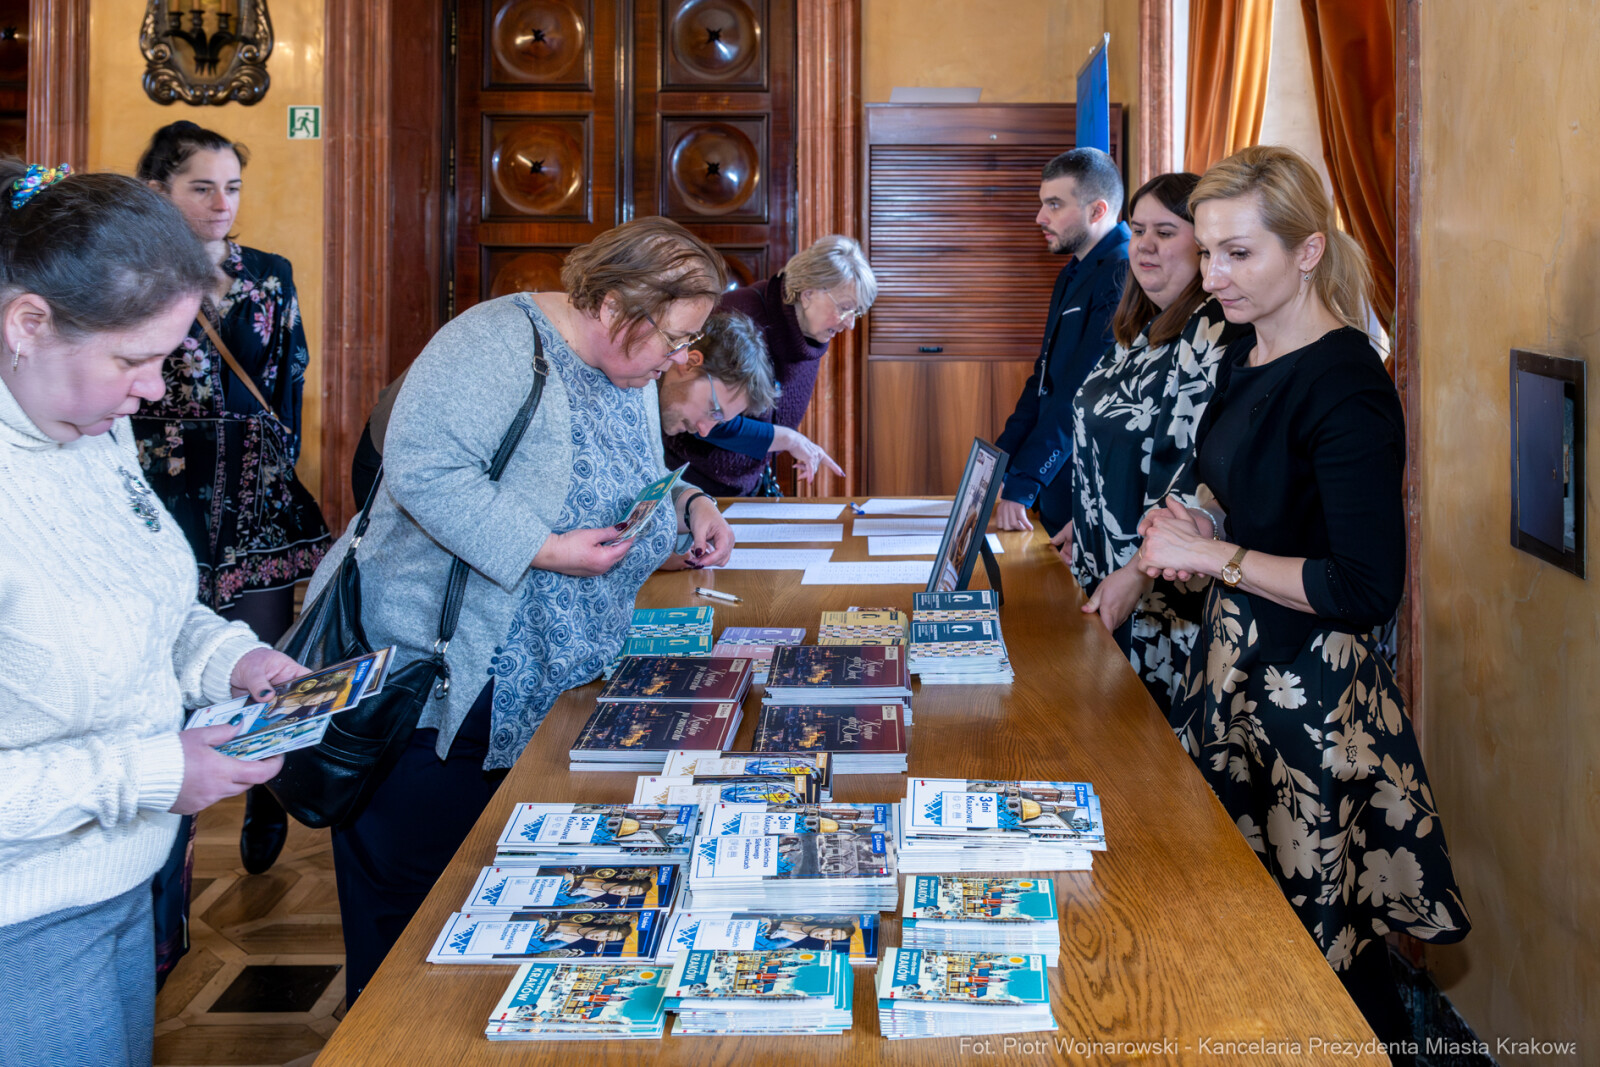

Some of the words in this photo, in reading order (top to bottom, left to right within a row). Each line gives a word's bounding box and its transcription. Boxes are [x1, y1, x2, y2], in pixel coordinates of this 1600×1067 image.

[917, 878, 929, 905] KRAKÓW
[684, 952, 702, 981] KRAKÓW
[895, 951, 911, 982] KRAKÓW
[516, 967, 544, 1002] KRAKÓW
